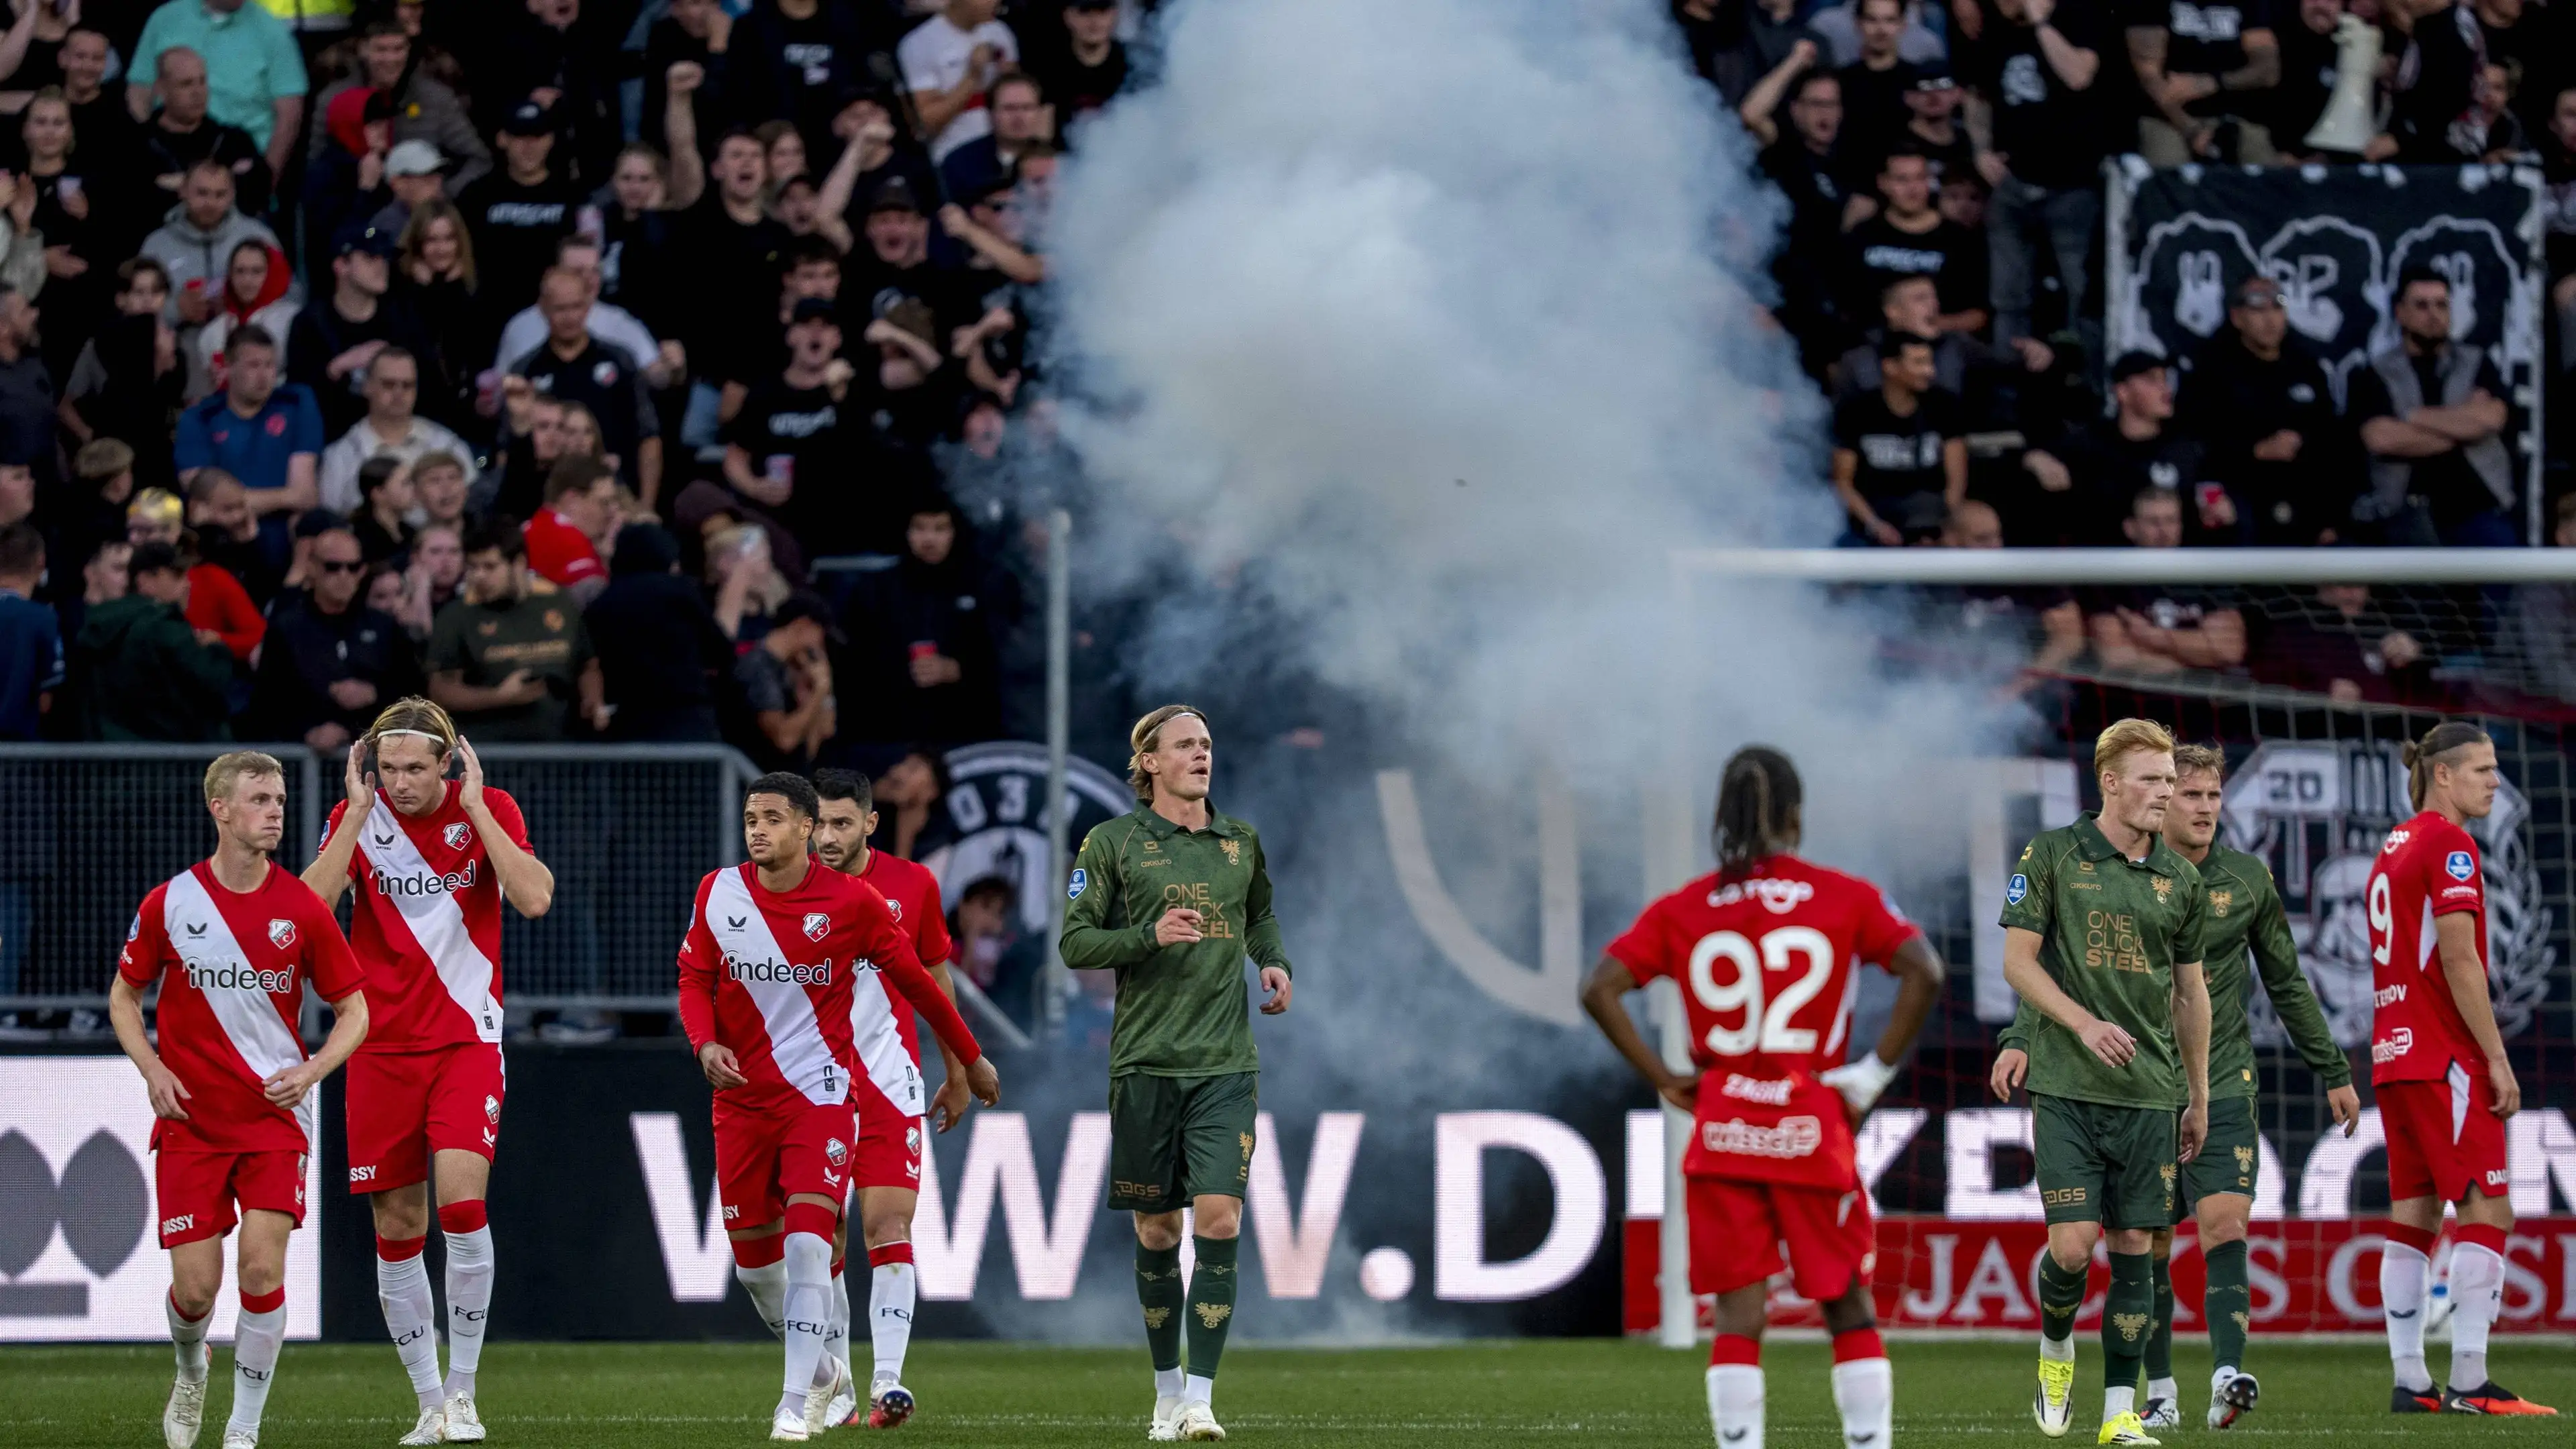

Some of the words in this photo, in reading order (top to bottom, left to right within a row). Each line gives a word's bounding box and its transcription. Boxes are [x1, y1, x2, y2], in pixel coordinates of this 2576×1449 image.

[1140, 859, 1173, 868] akkuro
[378, 858, 476, 896] indeed
[2070, 882, 2102, 892] akkuro
[1164, 882, 1210, 902] ONE
[2087, 910, 2133, 932] ONE
[2369, 872, 2394, 966] 9
[189, 961, 294, 994] indeed
[727, 955, 832, 985] indeed
[1688, 925, 1835, 1056] 92
[454, 1305, 487, 1322] FCU
[788, 1320, 824, 1336] FCU
[235, 1359, 270, 1381] FCU
